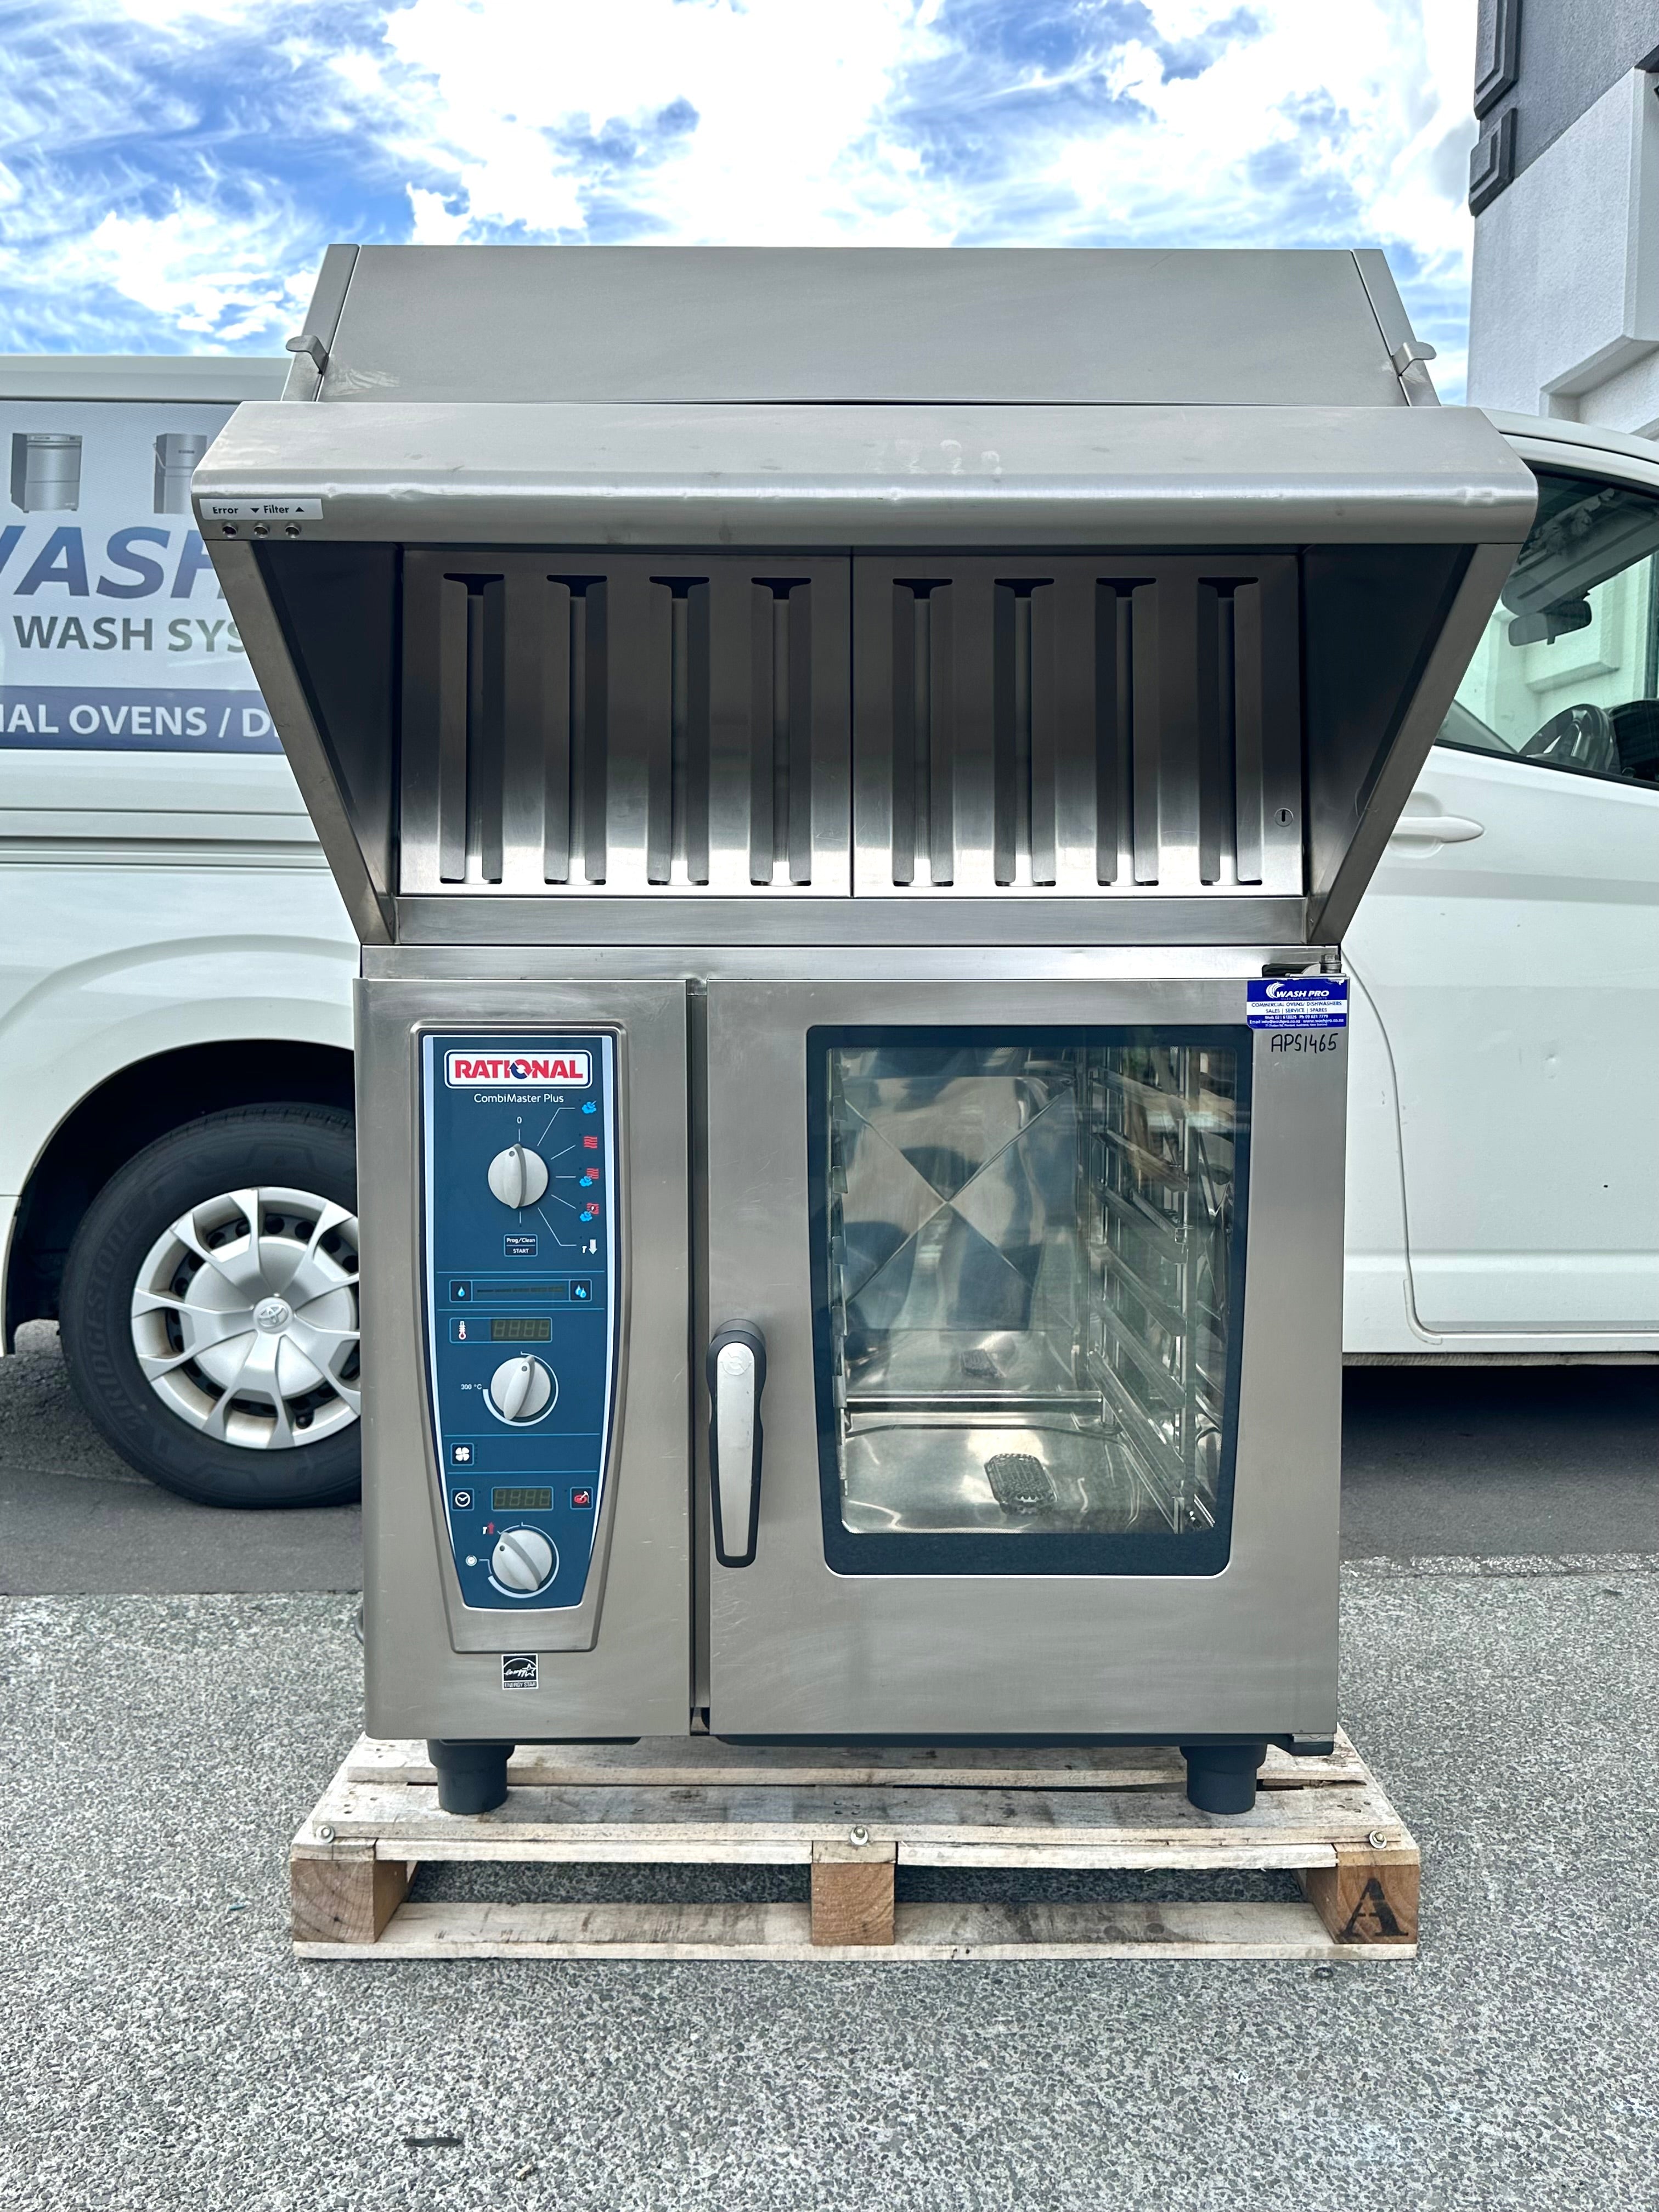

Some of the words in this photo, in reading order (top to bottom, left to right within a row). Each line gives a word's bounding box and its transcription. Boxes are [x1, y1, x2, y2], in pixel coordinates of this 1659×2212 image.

[263, 504, 290, 514] Filter
[13, 615, 153, 651] WASH
[69, 704, 207, 737] OVENS
[1271, 1032, 1339, 1054] APS1465
[455, 1059, 583, 1079] RATIONAL
[473, 1093, 541, 1103] CombiMaster
[544, 1093, 564, 1103] Plus
[1338, 1878, 1409, 1938] A
